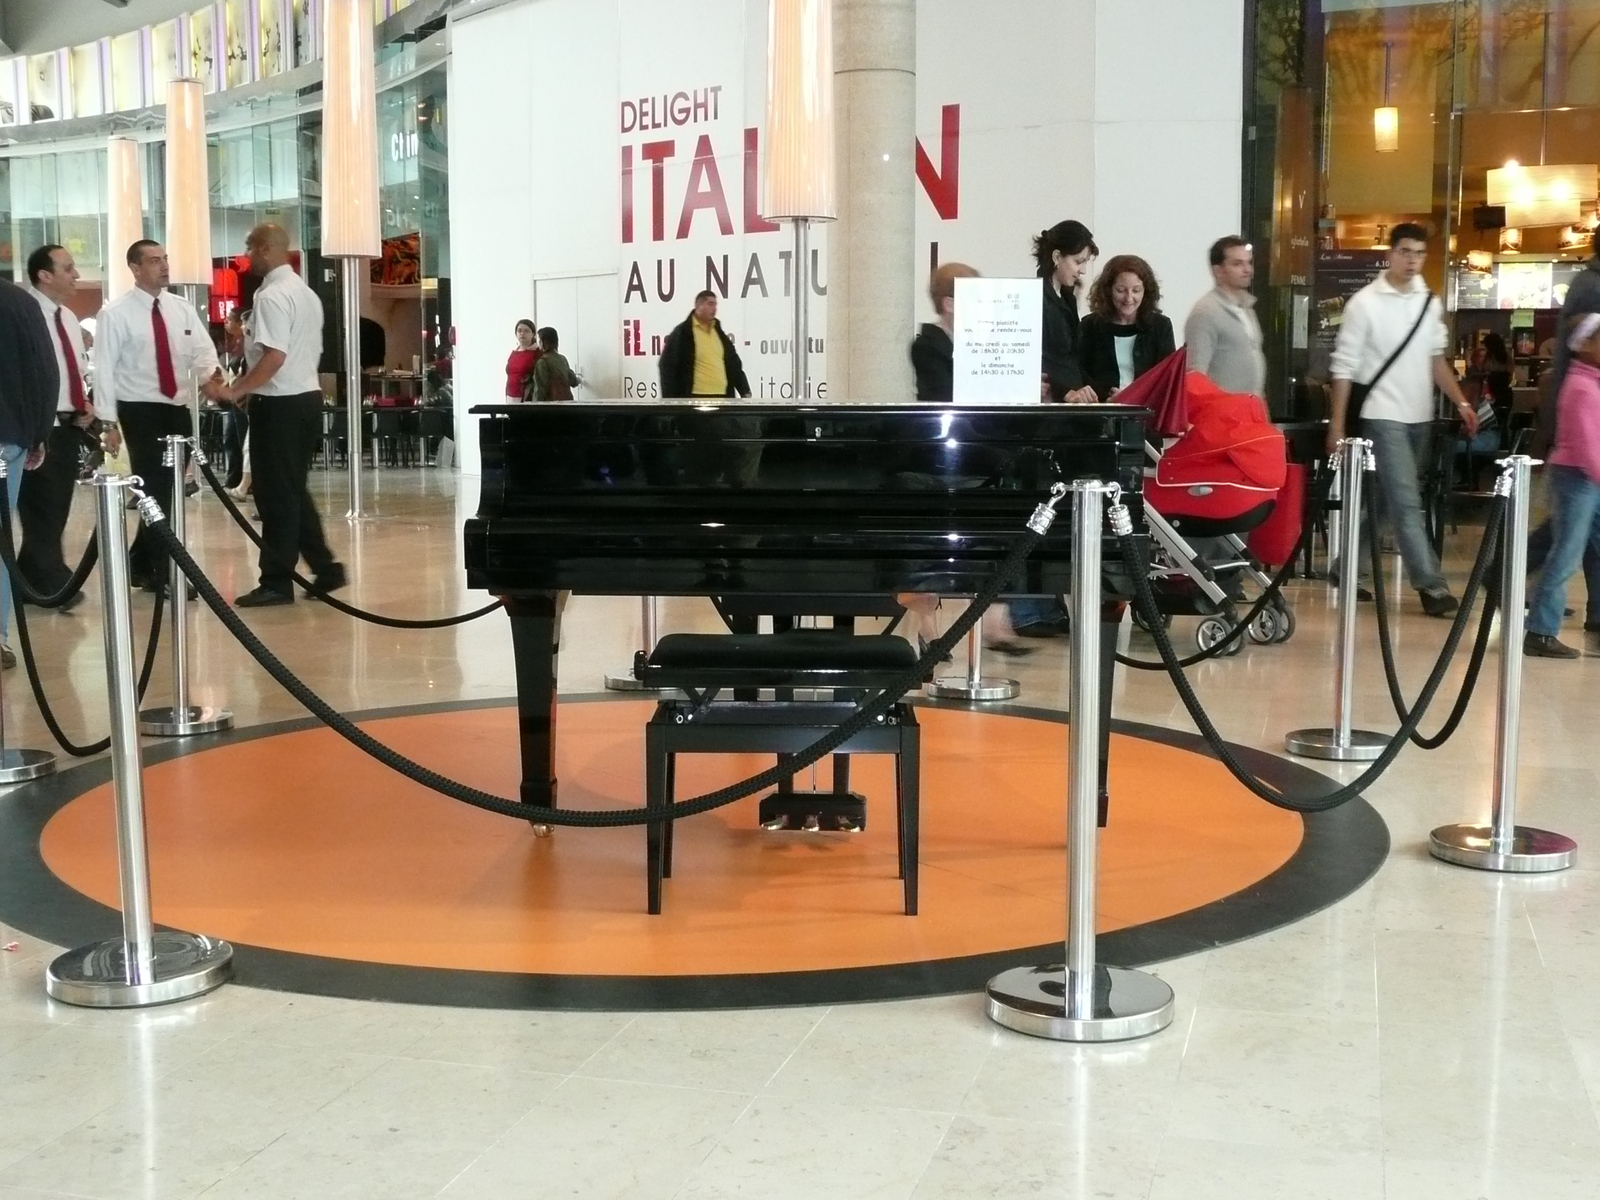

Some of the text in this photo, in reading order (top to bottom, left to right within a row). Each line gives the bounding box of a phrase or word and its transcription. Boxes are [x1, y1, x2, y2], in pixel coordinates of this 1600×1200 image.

[621, 85, 722, 133] DELIGHT
[621, 103, 961, 244] ITALN
[624, 242, 938, 304] AU NATU
[1375, 260, 1390, 268] 6.10
